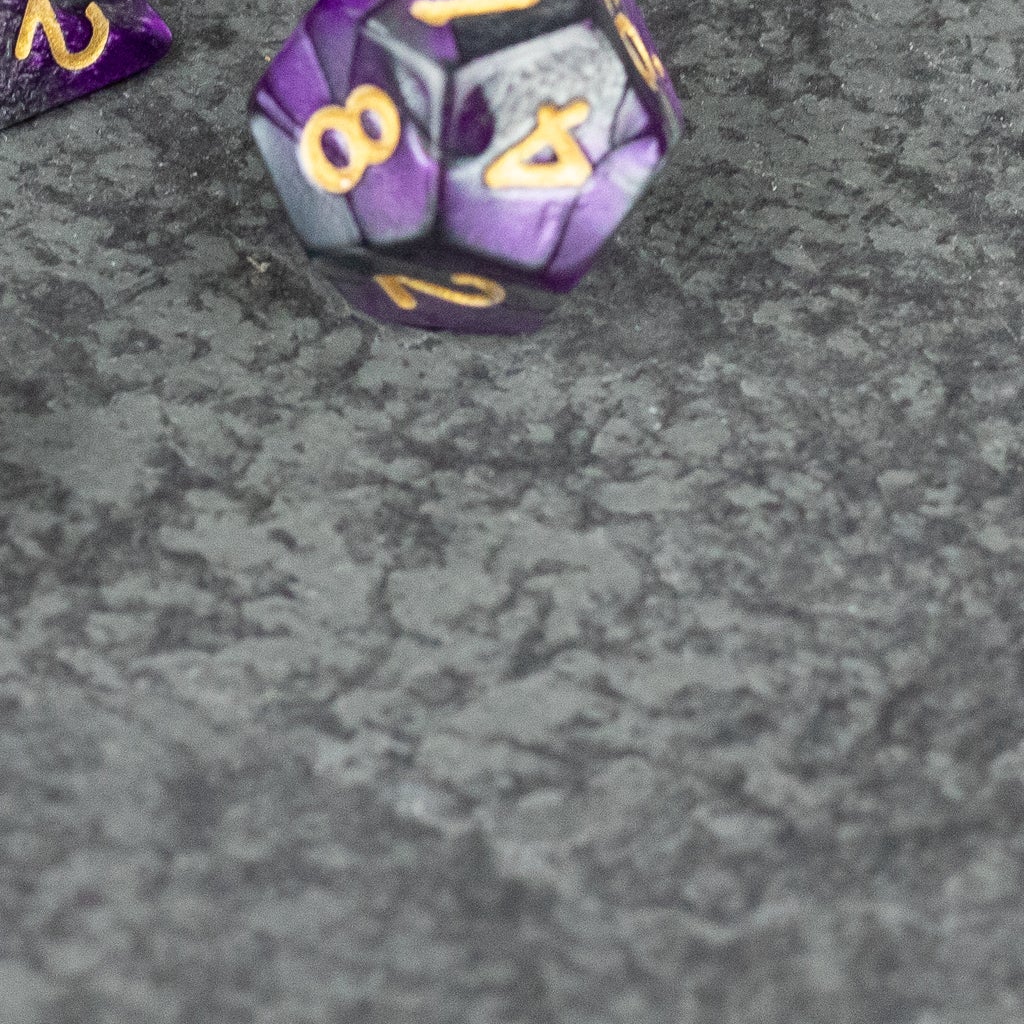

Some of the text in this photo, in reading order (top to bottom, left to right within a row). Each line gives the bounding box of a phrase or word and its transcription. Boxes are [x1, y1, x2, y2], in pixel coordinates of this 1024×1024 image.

[299, 84, 402, 194] 8
[483, 99, 593, 189] 4
[373, 272, 506, 310] 2
